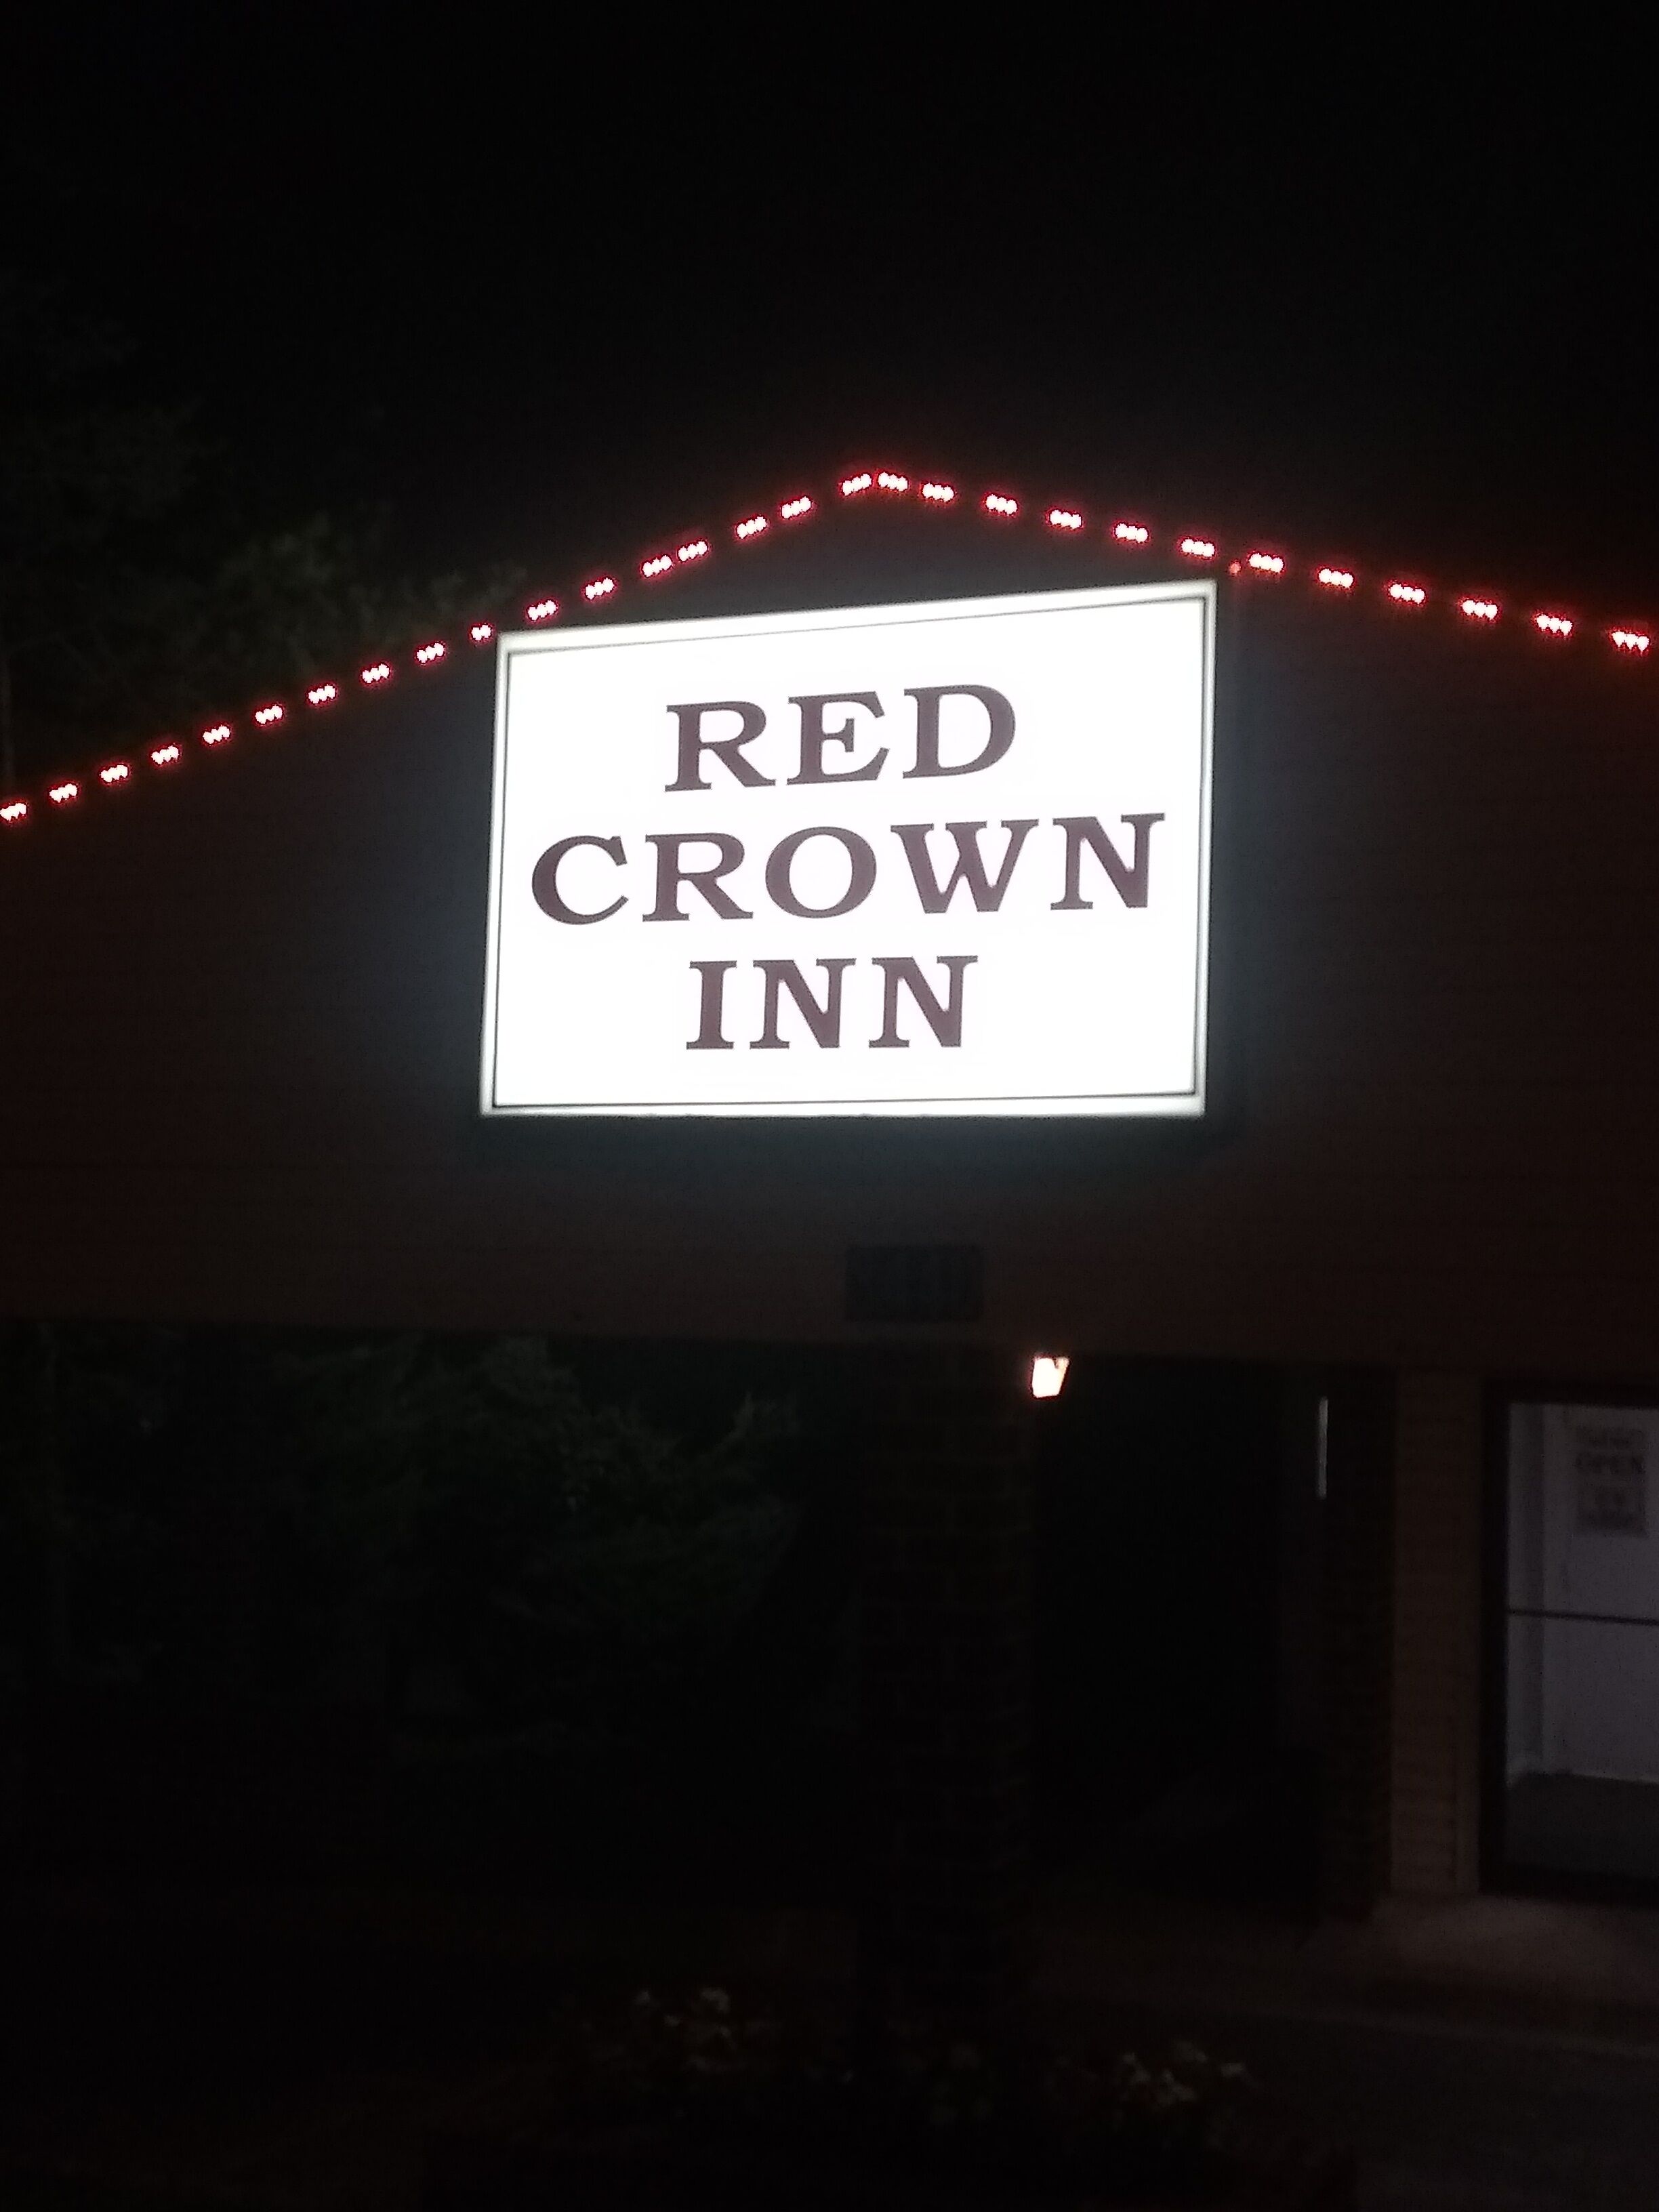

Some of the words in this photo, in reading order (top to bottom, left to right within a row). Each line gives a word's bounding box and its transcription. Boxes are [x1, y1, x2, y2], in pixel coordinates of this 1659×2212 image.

[664, 684, 1016, 792] RED
[531, 813, 1165, 925] CROWN
[686, 955, 979, 1050] INN
